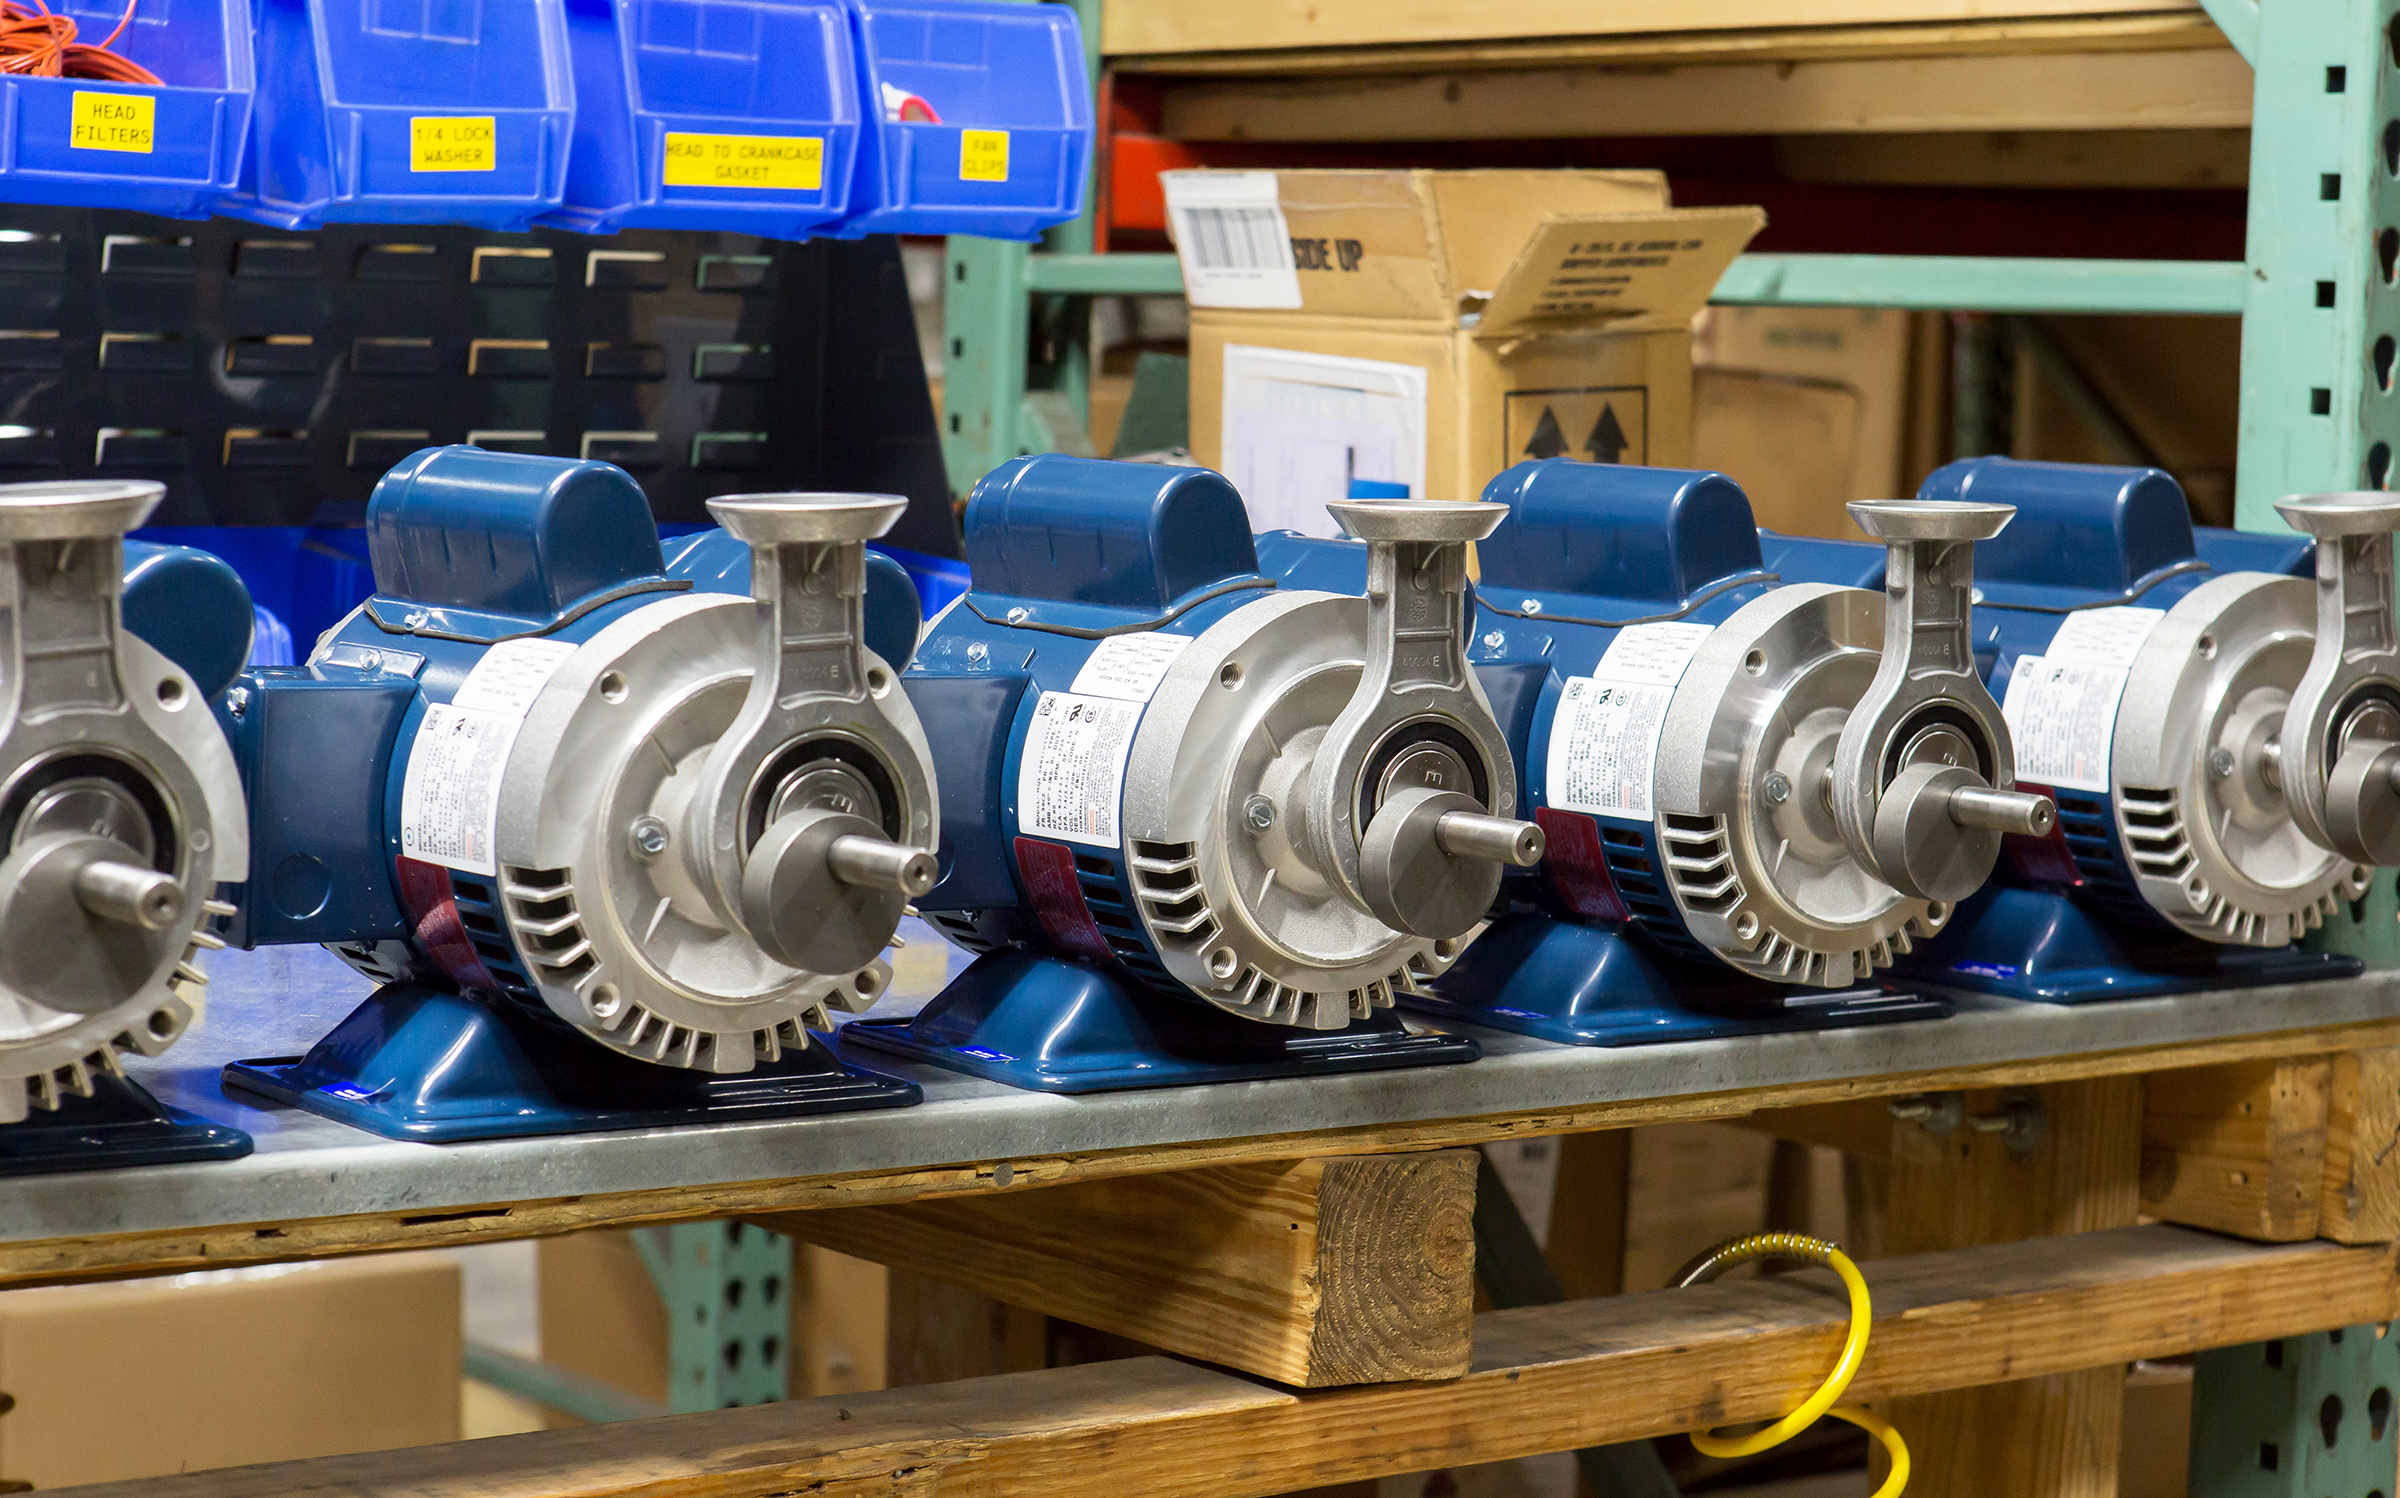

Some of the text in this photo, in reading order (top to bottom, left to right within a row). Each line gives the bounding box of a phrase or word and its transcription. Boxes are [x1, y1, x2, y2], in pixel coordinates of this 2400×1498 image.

[92, 103, 136, 120] HEAD
[75, 125, 150, 144] FILTERS
[416, 127, 493, 142] 1/4 LOCK
[666, 143, 820, 161] HEAD TO CRANKCASE
[973, 139, 999, 151] FAN
[423, 148, 484, 163] WASHER
[715, 165, 770, 180] GASKET
[963, 159, 1006, 174] CLIPS
[1334, 239, 1363, 272] UP
[1613, 731, 1622, 768] PROTECTED
[1080, 750, 1089, 791] PROTECTED
